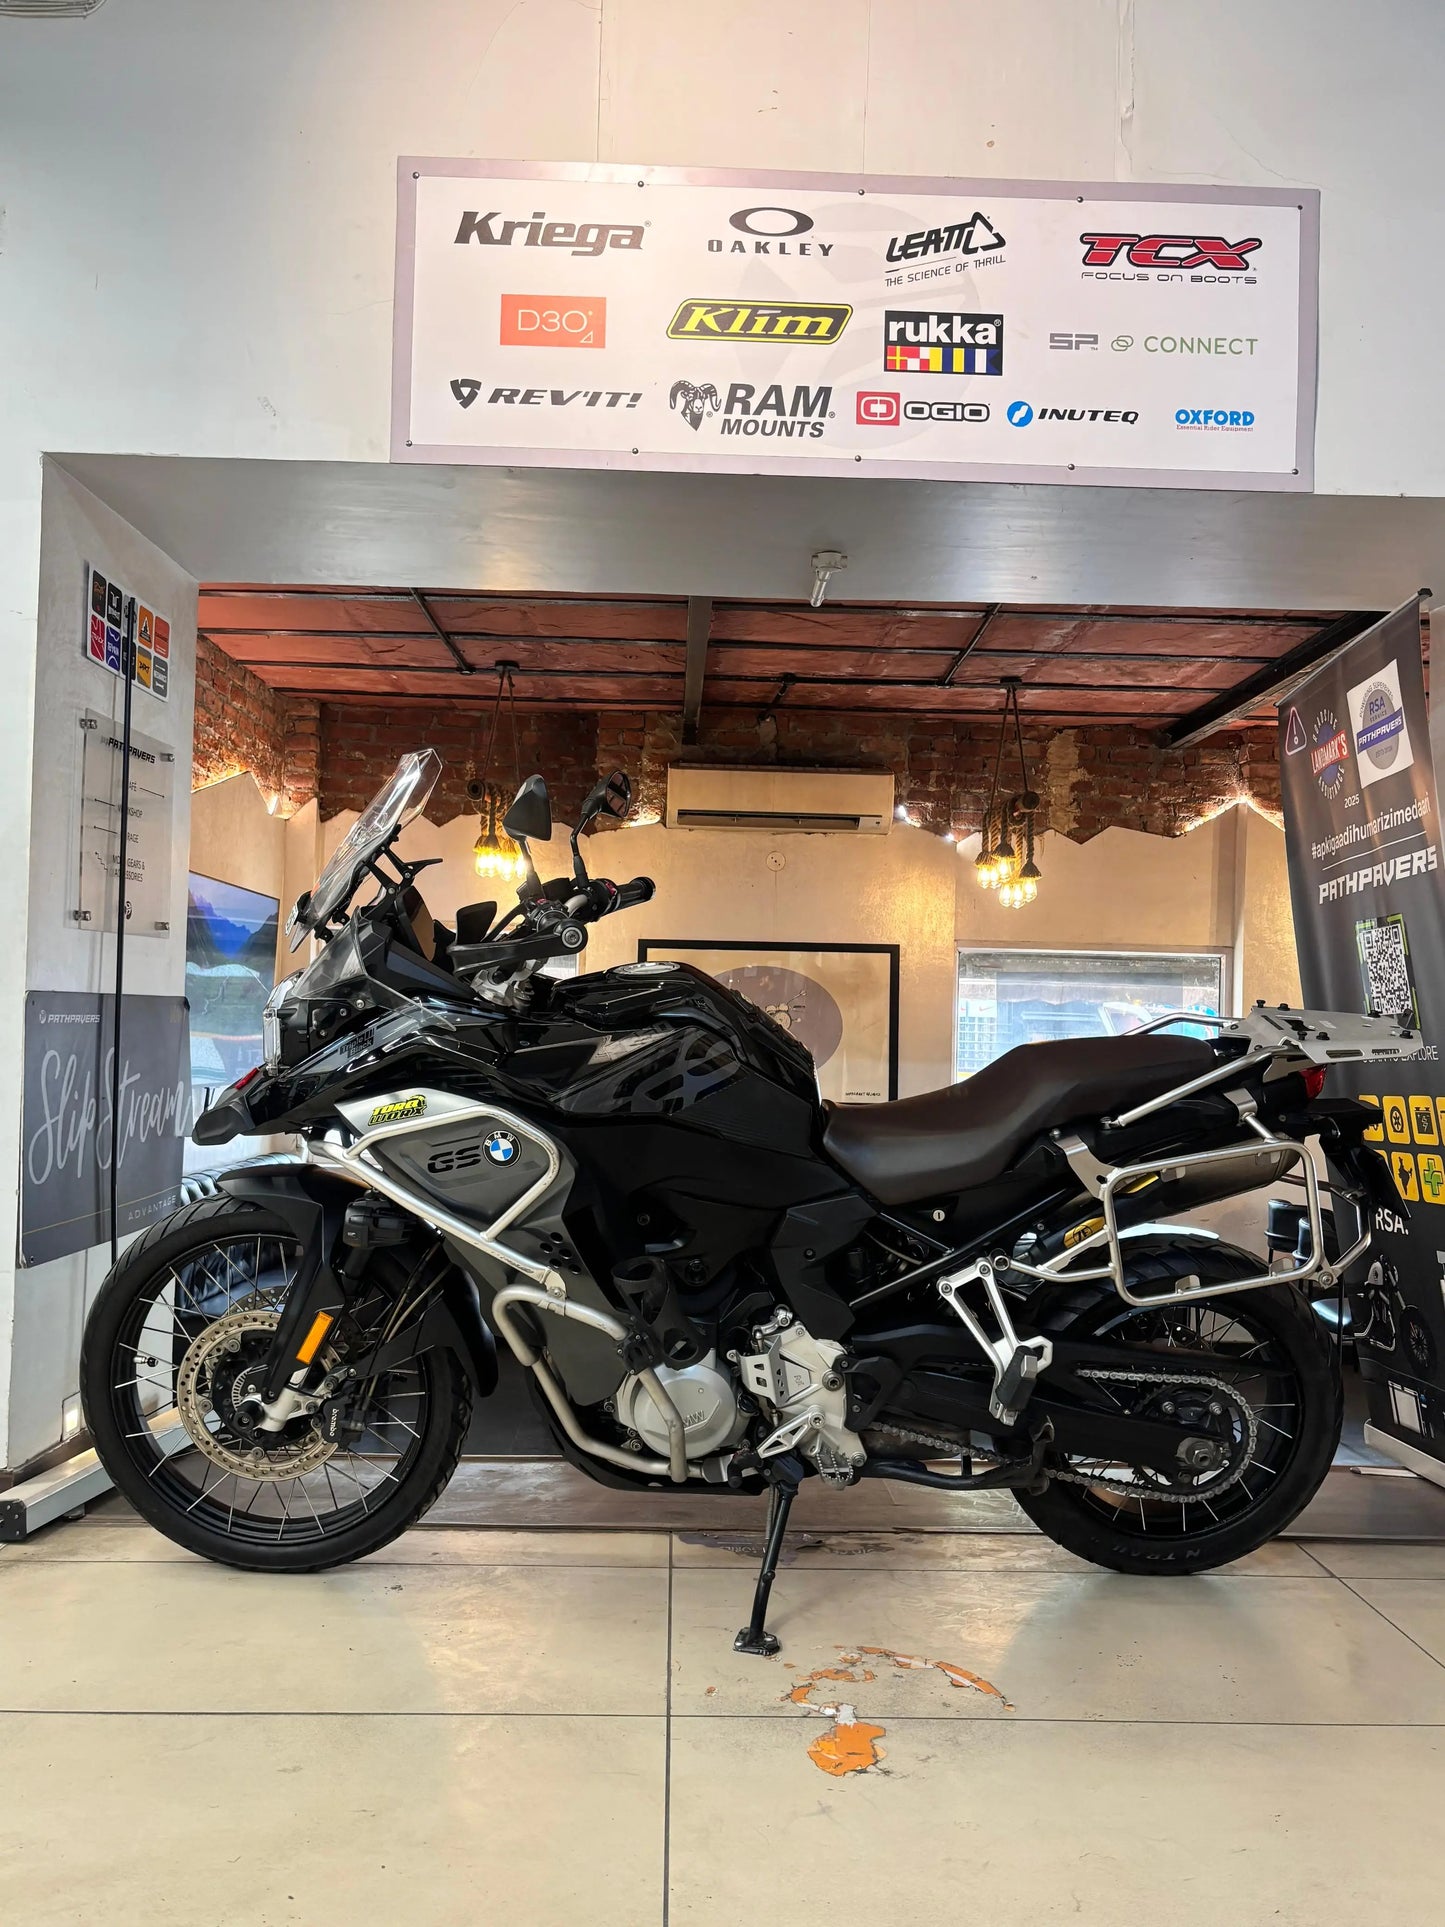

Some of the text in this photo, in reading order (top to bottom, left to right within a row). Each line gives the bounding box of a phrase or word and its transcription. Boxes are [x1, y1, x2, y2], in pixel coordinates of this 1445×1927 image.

[454, 211, 645, 256] Kriega
[707, 239, 834, 257] OAKLEY
[1080, 232, 1262, 271] TCX
[885, 254, 1006, 287] THE SCIENCE OF THRILL
[1081, 271, 1257, 285] FOCUS ON BOOTS
[678, 306, 834, 339] Klim
[888, 314, 997, 345] rukka
[1143, 336, 1259, 356] CONNECT
[487, 387, 643, 409] REV'IT!
[724, 383, 832, 419] RAM
[903, 401, 990, 423] OGIO
[1038, 407, 1139, 425] INUTEQ
[1175, 408, 1255, 426] OXFORD
[720, 418, 825, 439] MOUNTS
[1176, 424, 1203, 432] Essential
[1221, 425, 1254, 433] Equipment
[1369, 696, 1386, 716] RSA
[1313, 708, 1339, 743] ROADSIDE
[1358, 715, 1402, 748] PATHPAVERS
[108, 737, 156, 764] PATPAVERS
[1311, 732, 1348, 774] LANDMARK'S
[1344, 793, 1360, 809] 2025
[1319, 845, 1438, 905] PATHPAVERS
[47, 1013, 101, 1024] PATHPAVERS
[484, 1130, 515, 1147] BMW
[427, 1144, 482, 1174] GS
[128, 1194, 177, 1221] ADVANTAGE
[1375, 1207, 1409, 1236] RSA.
[329, 1408, 340, 1437] brembo
